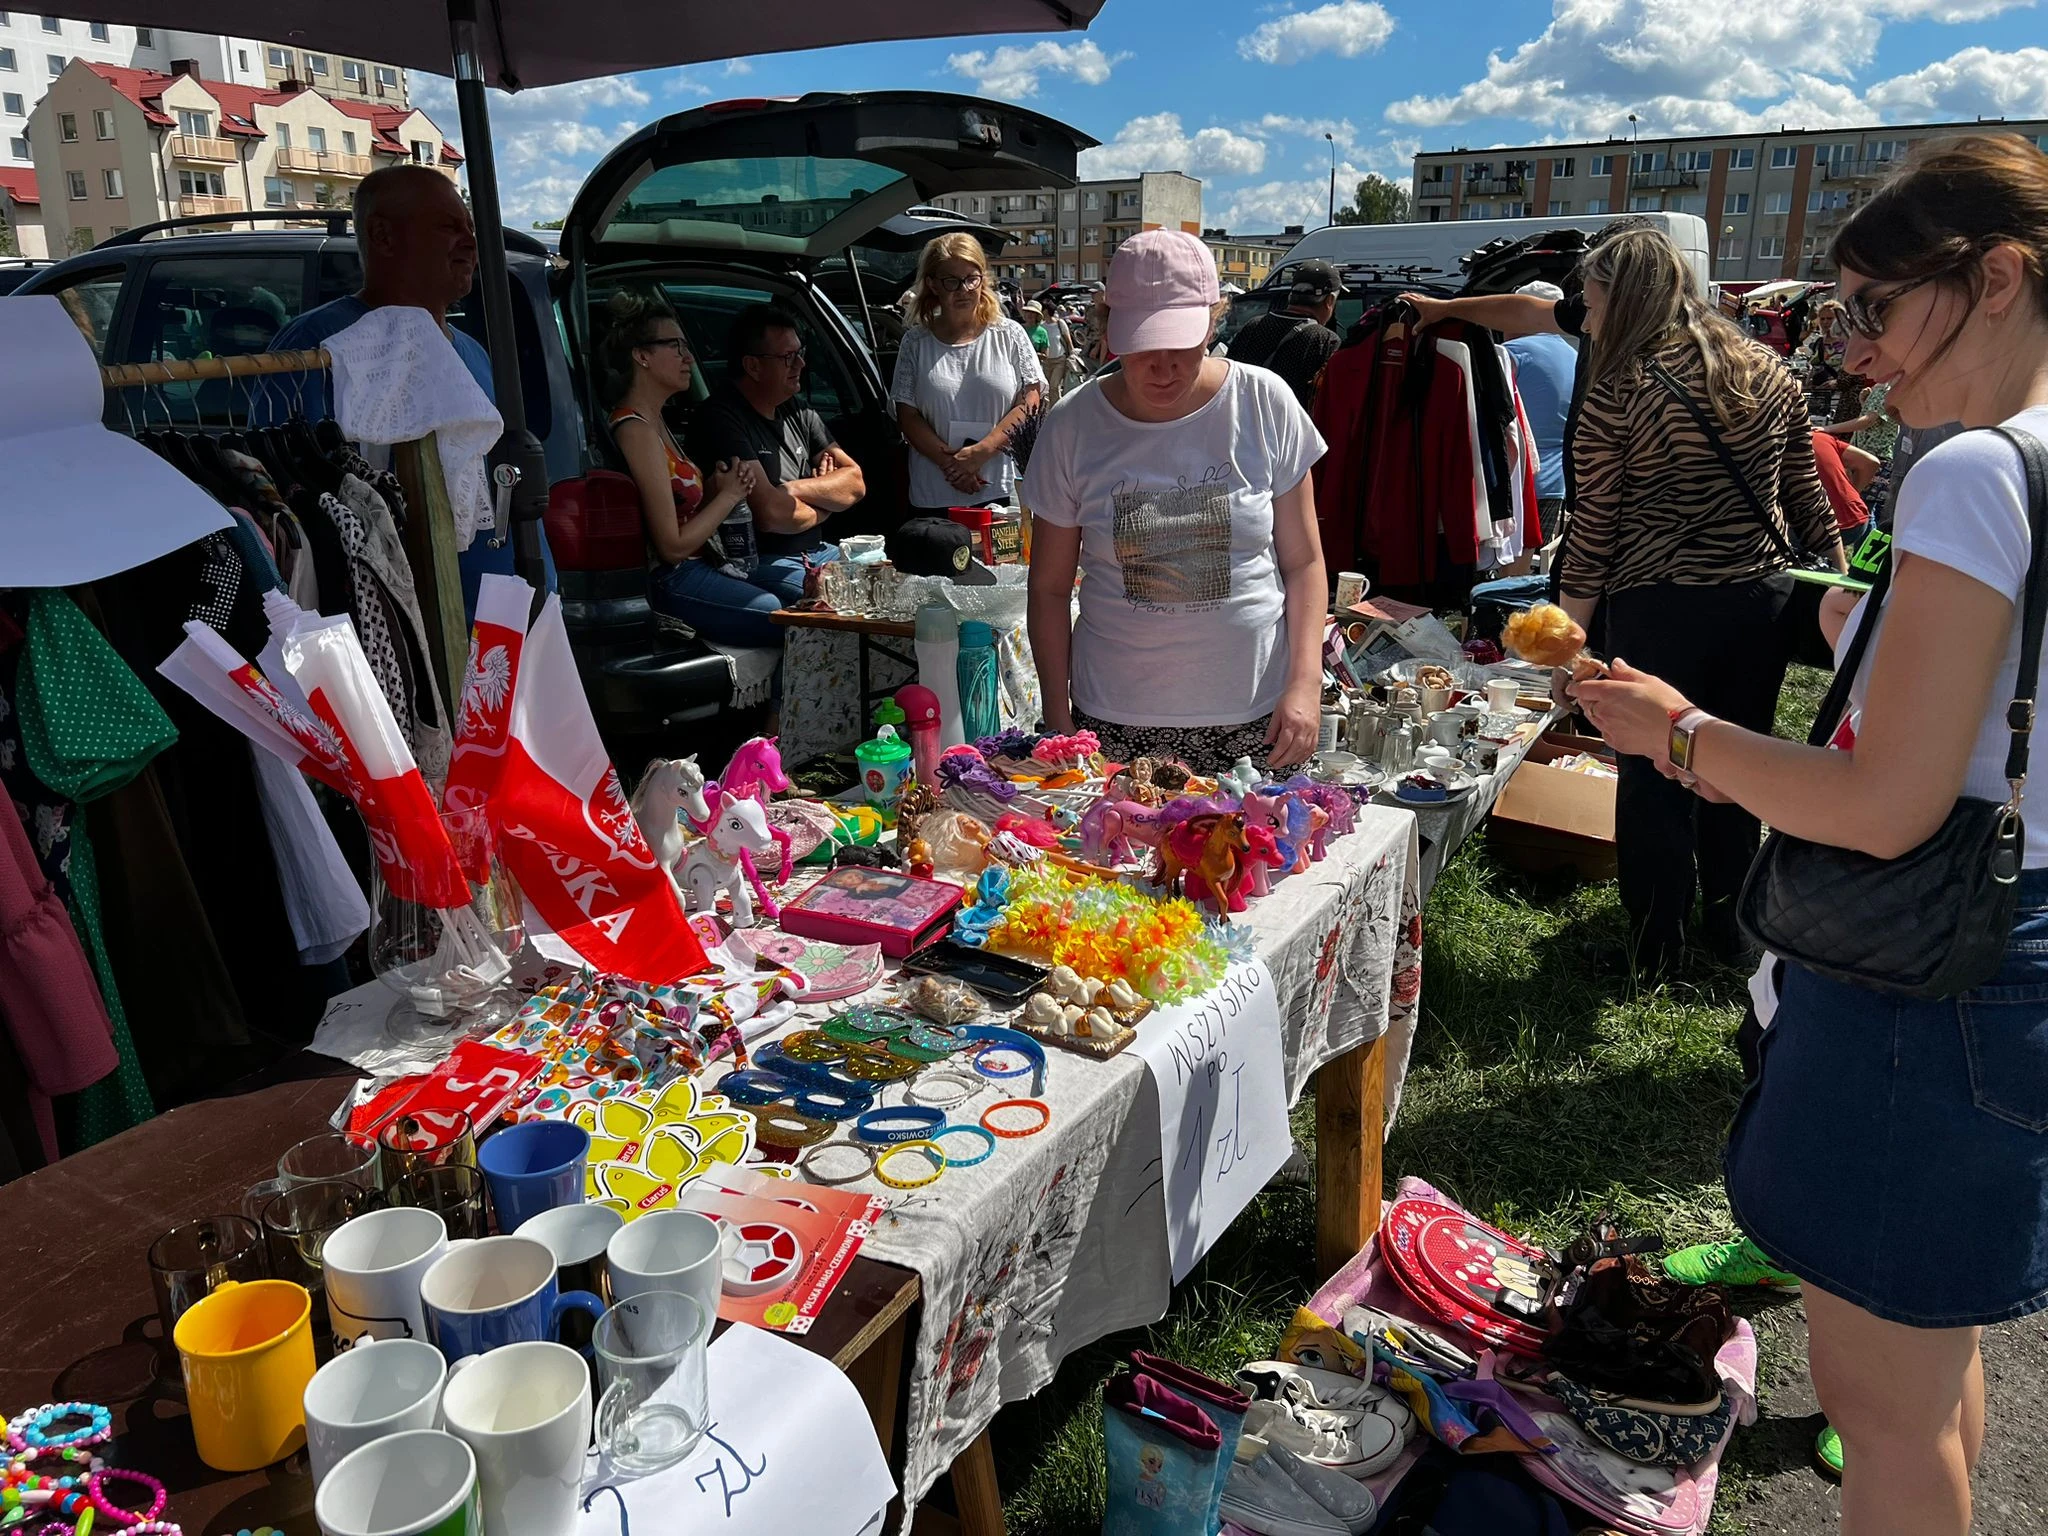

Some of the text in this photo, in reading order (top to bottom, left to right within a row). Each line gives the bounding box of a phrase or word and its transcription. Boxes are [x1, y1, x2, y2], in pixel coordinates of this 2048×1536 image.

[997, 537, 1017, 551] STEEL
[1166, 967, 1260, 1086] WSZYSTKO
[800, 1285, 823, 1315] POLSKA
